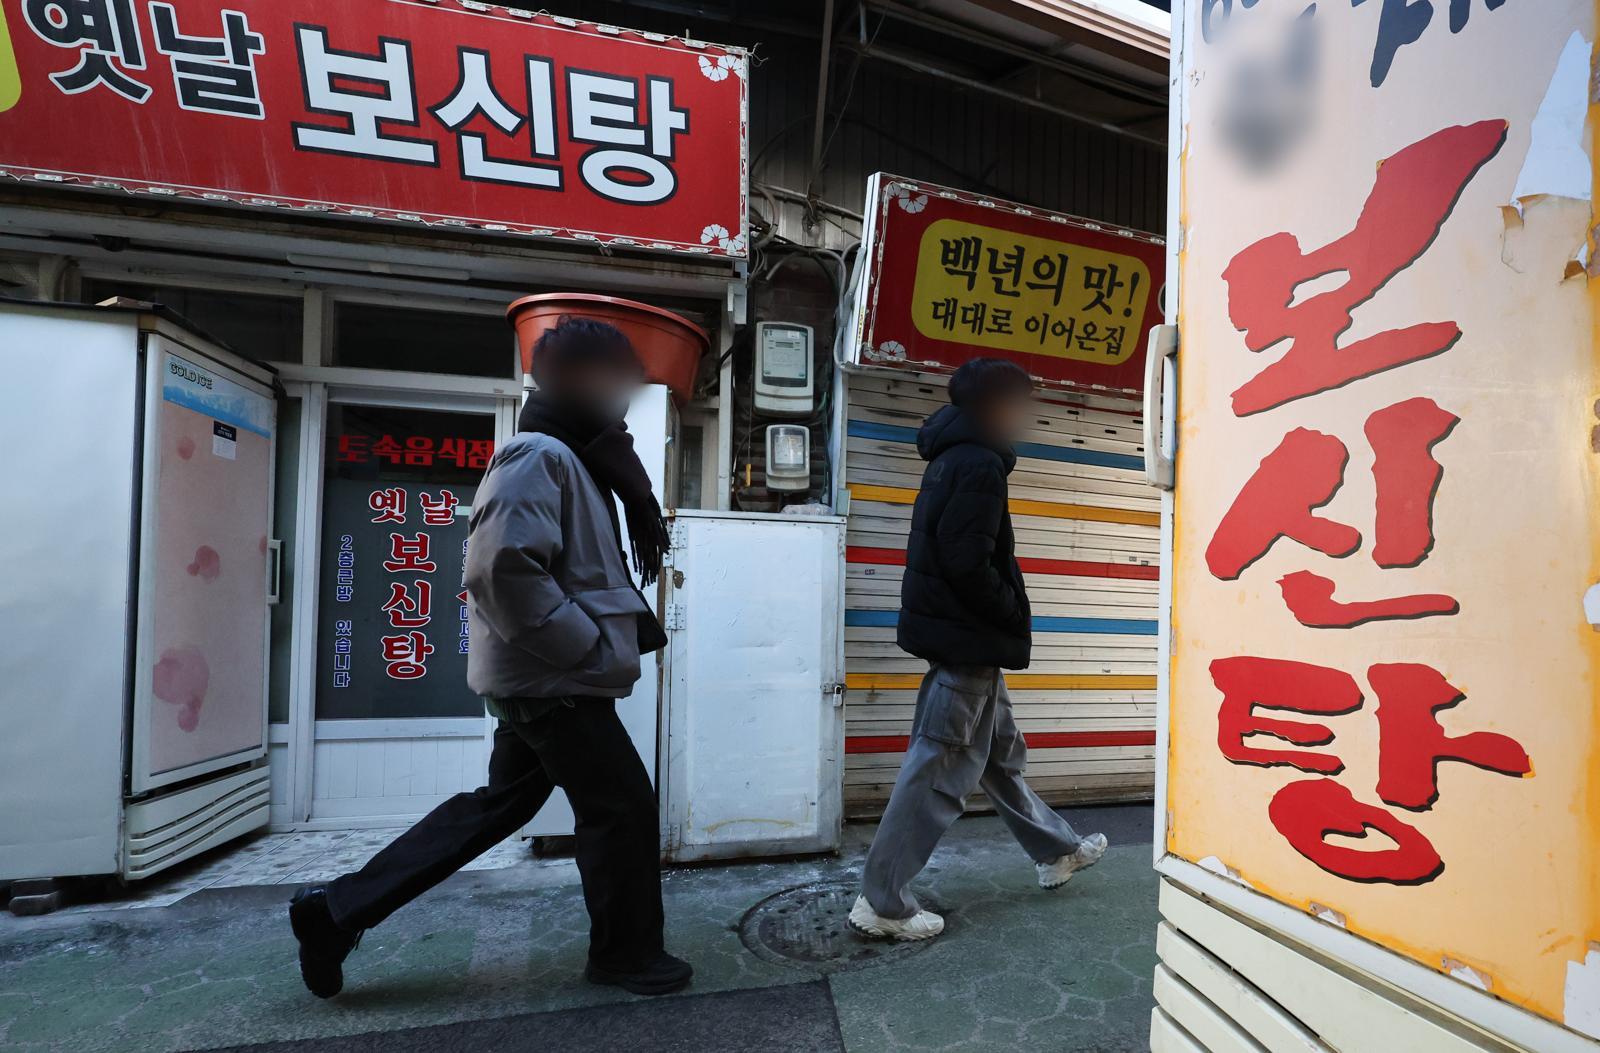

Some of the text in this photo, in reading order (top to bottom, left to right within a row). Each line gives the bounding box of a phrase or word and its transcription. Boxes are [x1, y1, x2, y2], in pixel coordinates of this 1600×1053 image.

[21, 0, 690, 206] 옛날 보신탕
[939, 235, 1141, 319] 백년의 맛!
[931, 297, 1126, 356] 대대로 이어온집
[335, 434, 496, 469] 토속음식점
[1205, 118, 1536, 887] 보신탕
[380, 532, 437, 680] 보신탕
[333, 619, 352, 688] 있습니다
